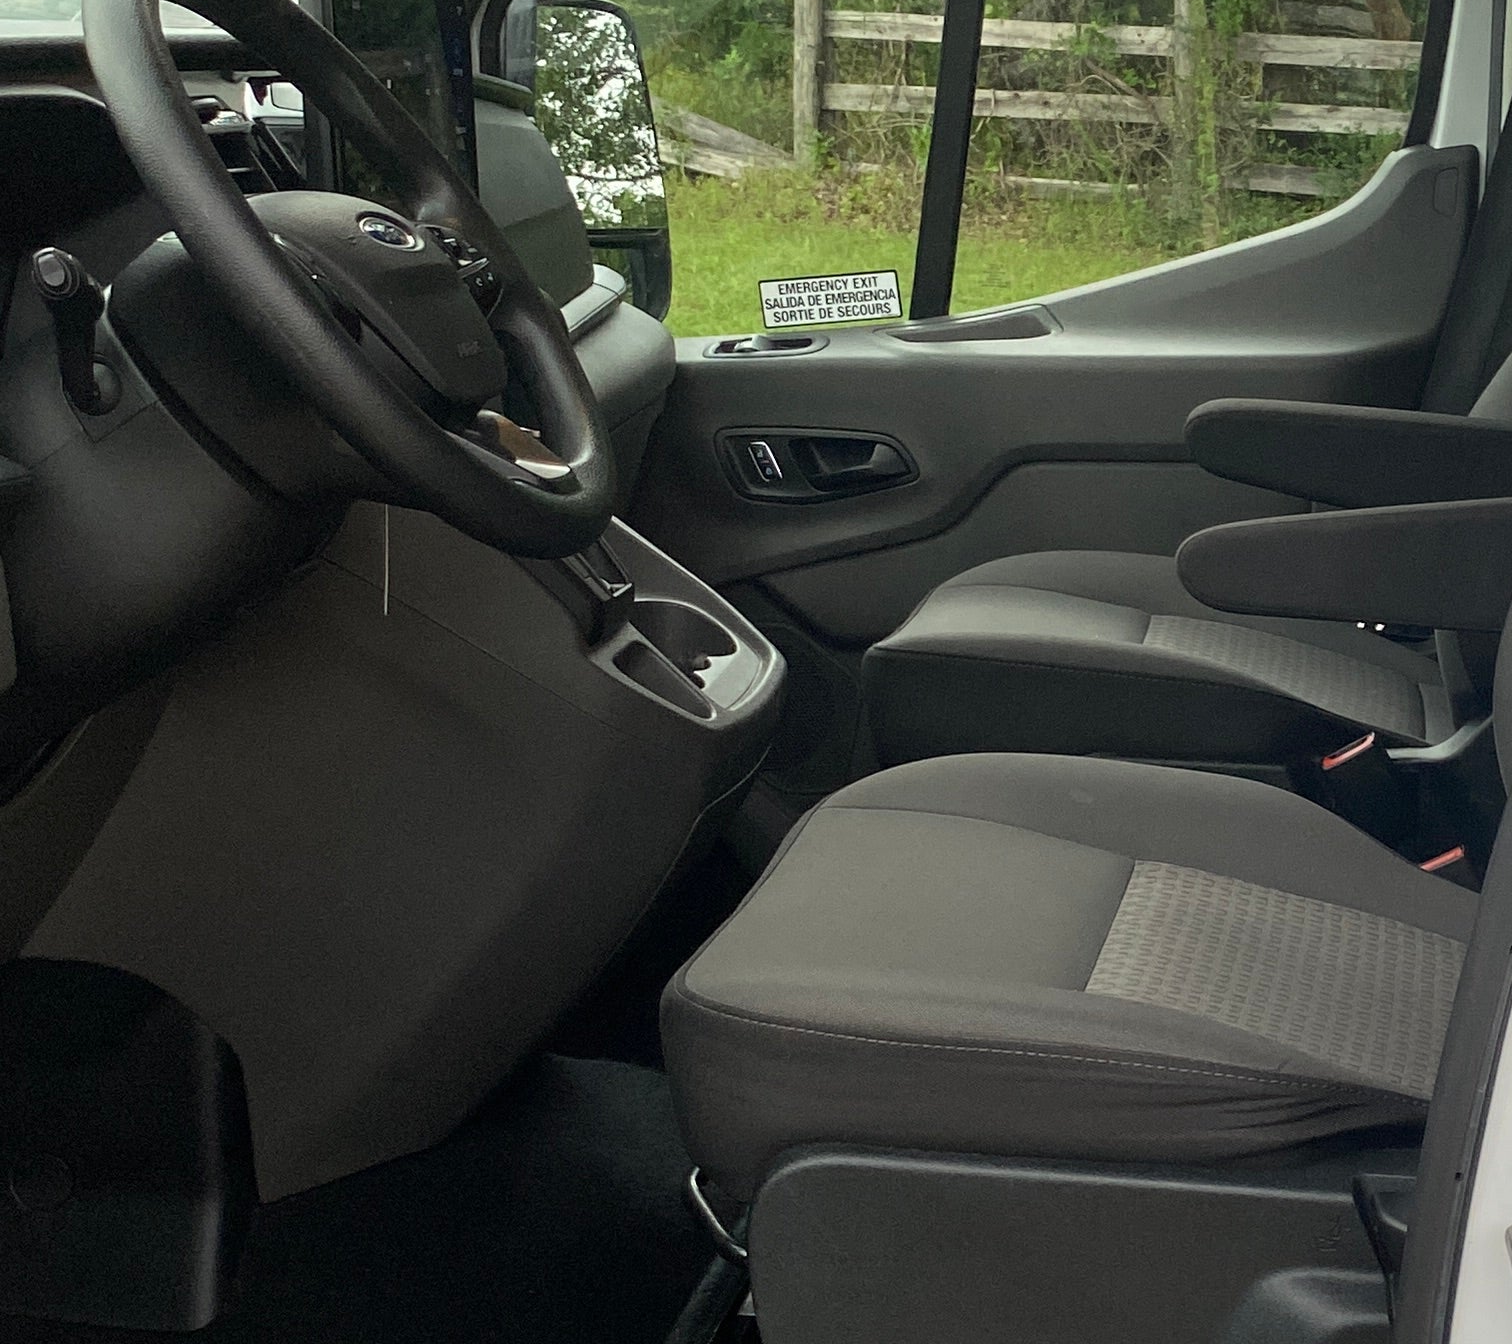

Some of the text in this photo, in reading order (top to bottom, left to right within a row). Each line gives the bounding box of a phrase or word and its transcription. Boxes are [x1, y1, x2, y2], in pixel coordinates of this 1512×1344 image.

[777, 276, 878, 295] EMERGENCY EXIT
[765, 288, 896, 310] SALIDA DE EMERGENCIA
[773, 302, 892, 323] SORTIE DE SECOURS
